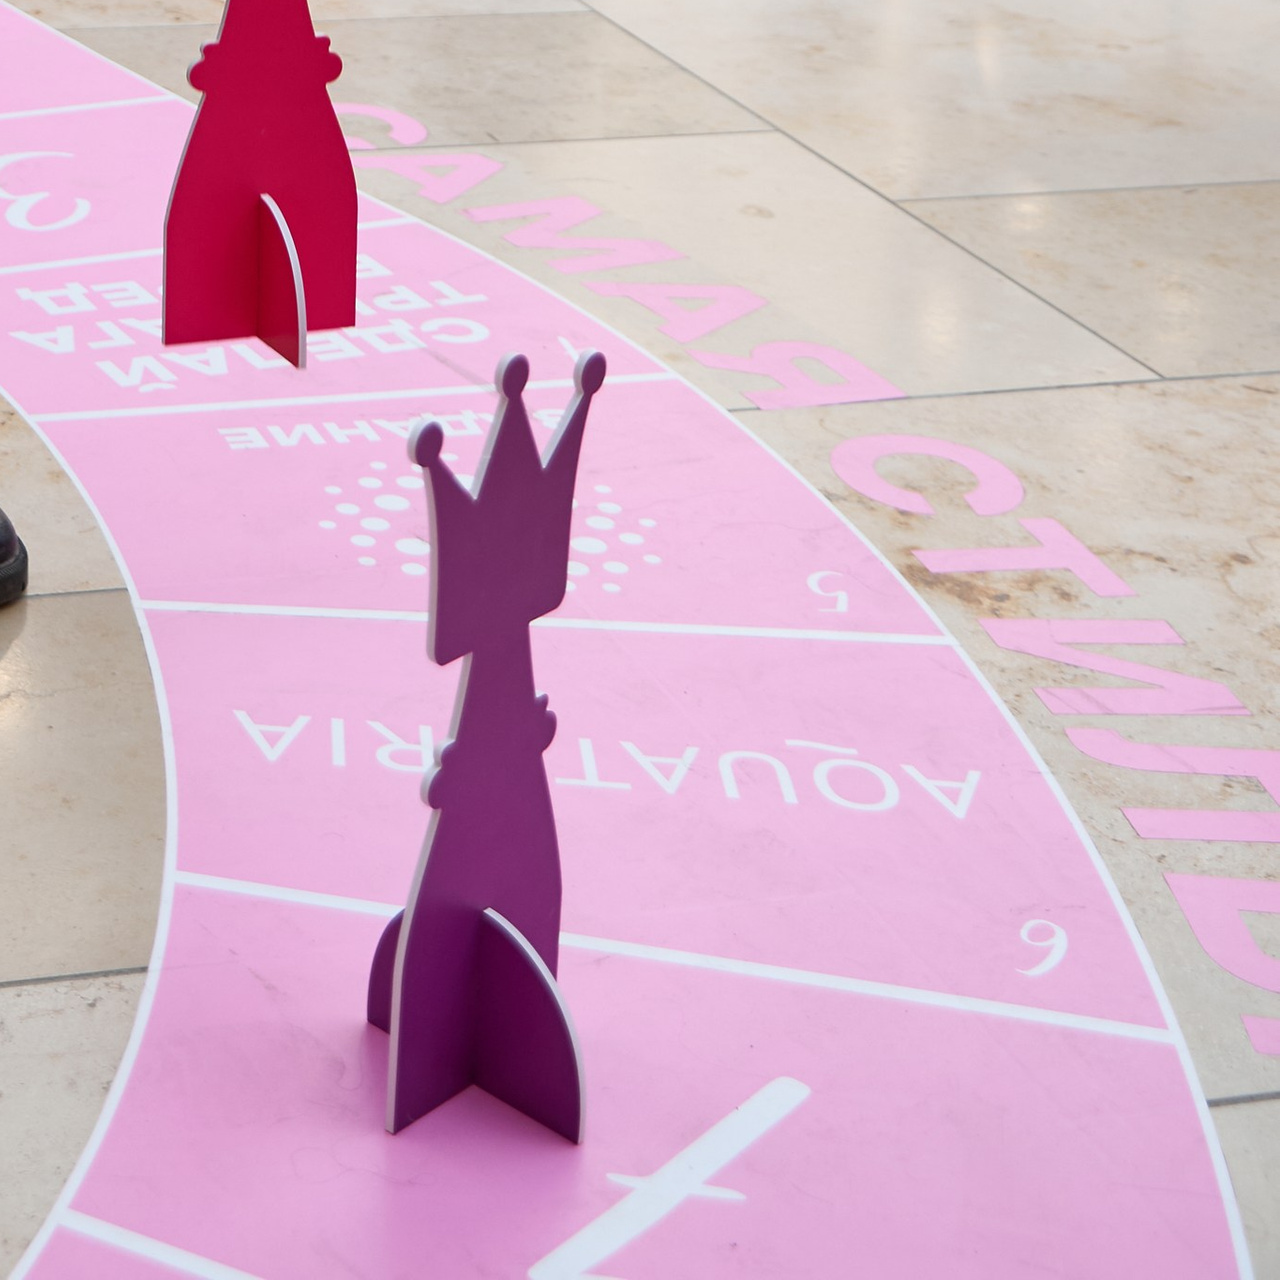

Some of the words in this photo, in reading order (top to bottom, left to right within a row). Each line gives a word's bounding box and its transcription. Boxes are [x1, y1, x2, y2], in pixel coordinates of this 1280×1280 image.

[332, 101, 908, 410] САМАЯ
[355, 280, 489, 317] ТР
[217, 408, 568, 451] ЗДАНИЕ
[806, 570, 851, 614] 5
[233, 709, 982, 820] AQUATRIA
[1014, 918, 1070, 978] 6
